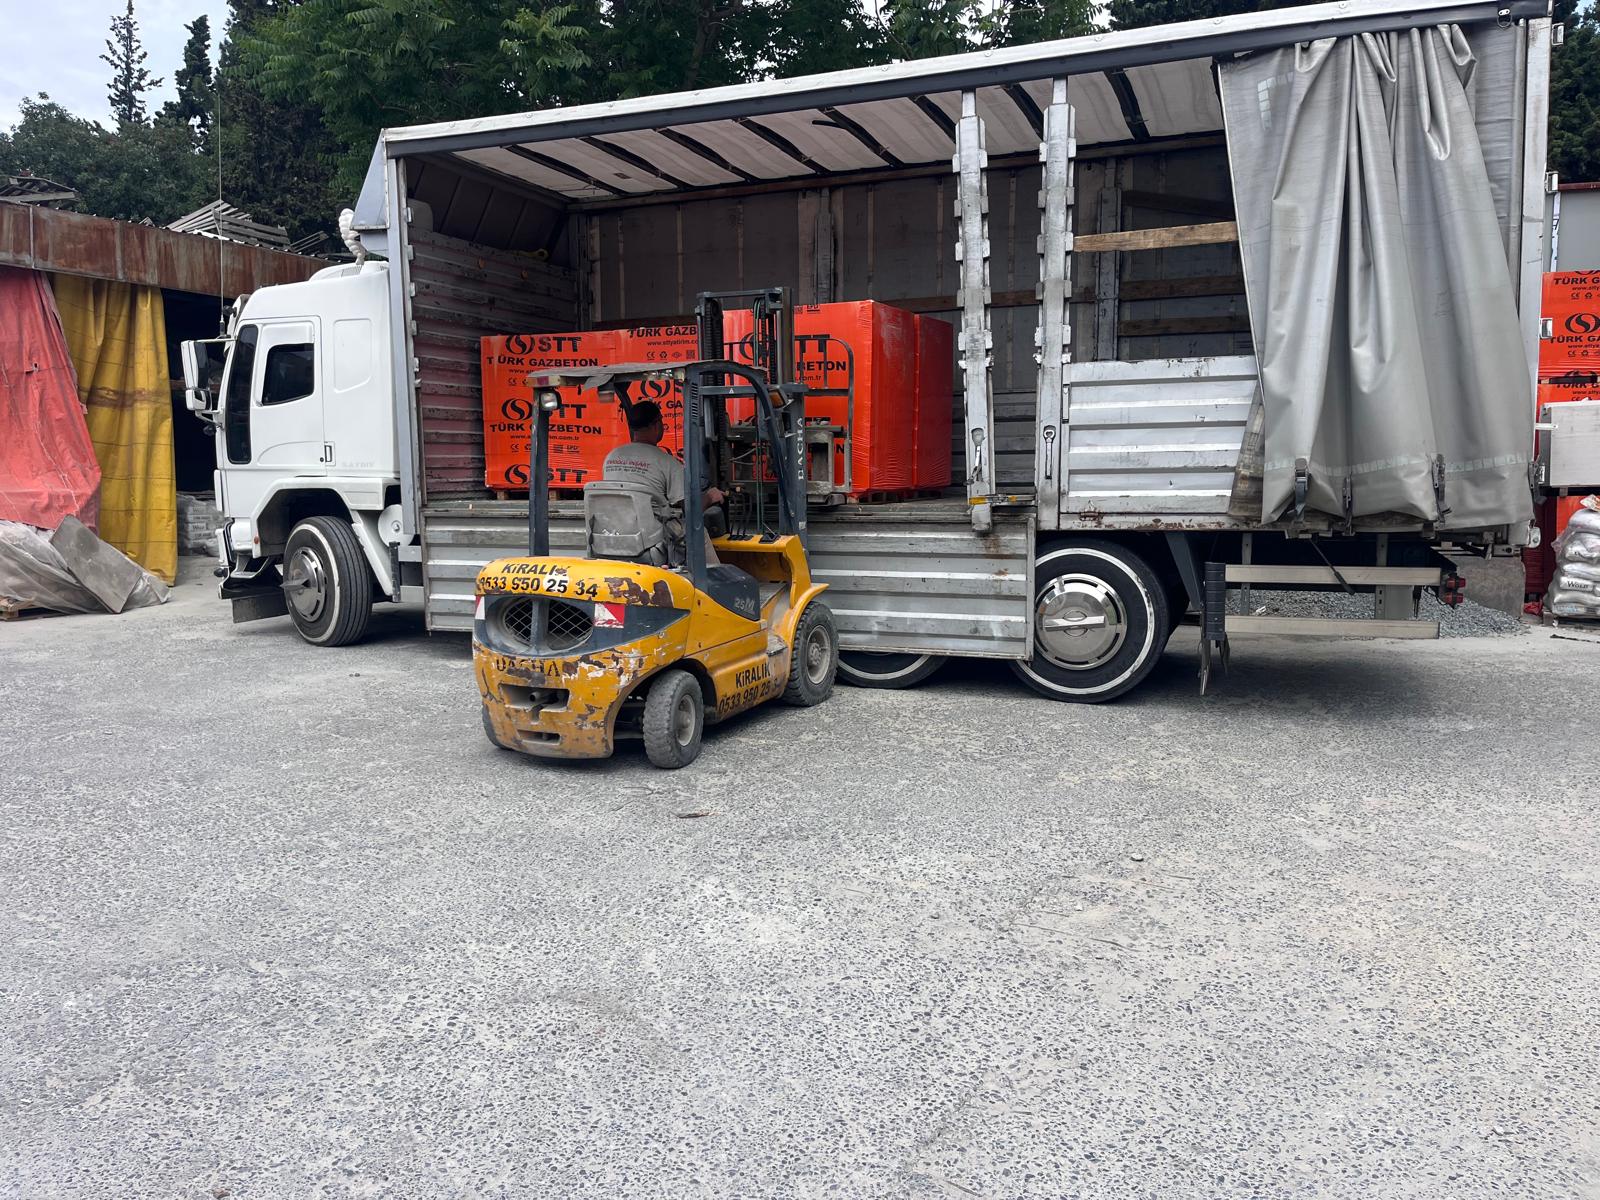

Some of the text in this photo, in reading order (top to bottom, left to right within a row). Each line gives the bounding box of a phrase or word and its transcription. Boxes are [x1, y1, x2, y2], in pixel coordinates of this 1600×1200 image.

[1554, 276, 1587, 285] TÜRK
[665, 326, 697, 336] GAZB
[538, 336, 582, 352] STT
[795, 334, 830, 353] TT
[529, 358, 598, 367] GAZBETON
[559, 404, 587, 419] TT
[490, 422, 602, 434] TÜRK ZBETON
[545, 579, 568, 593] 25
